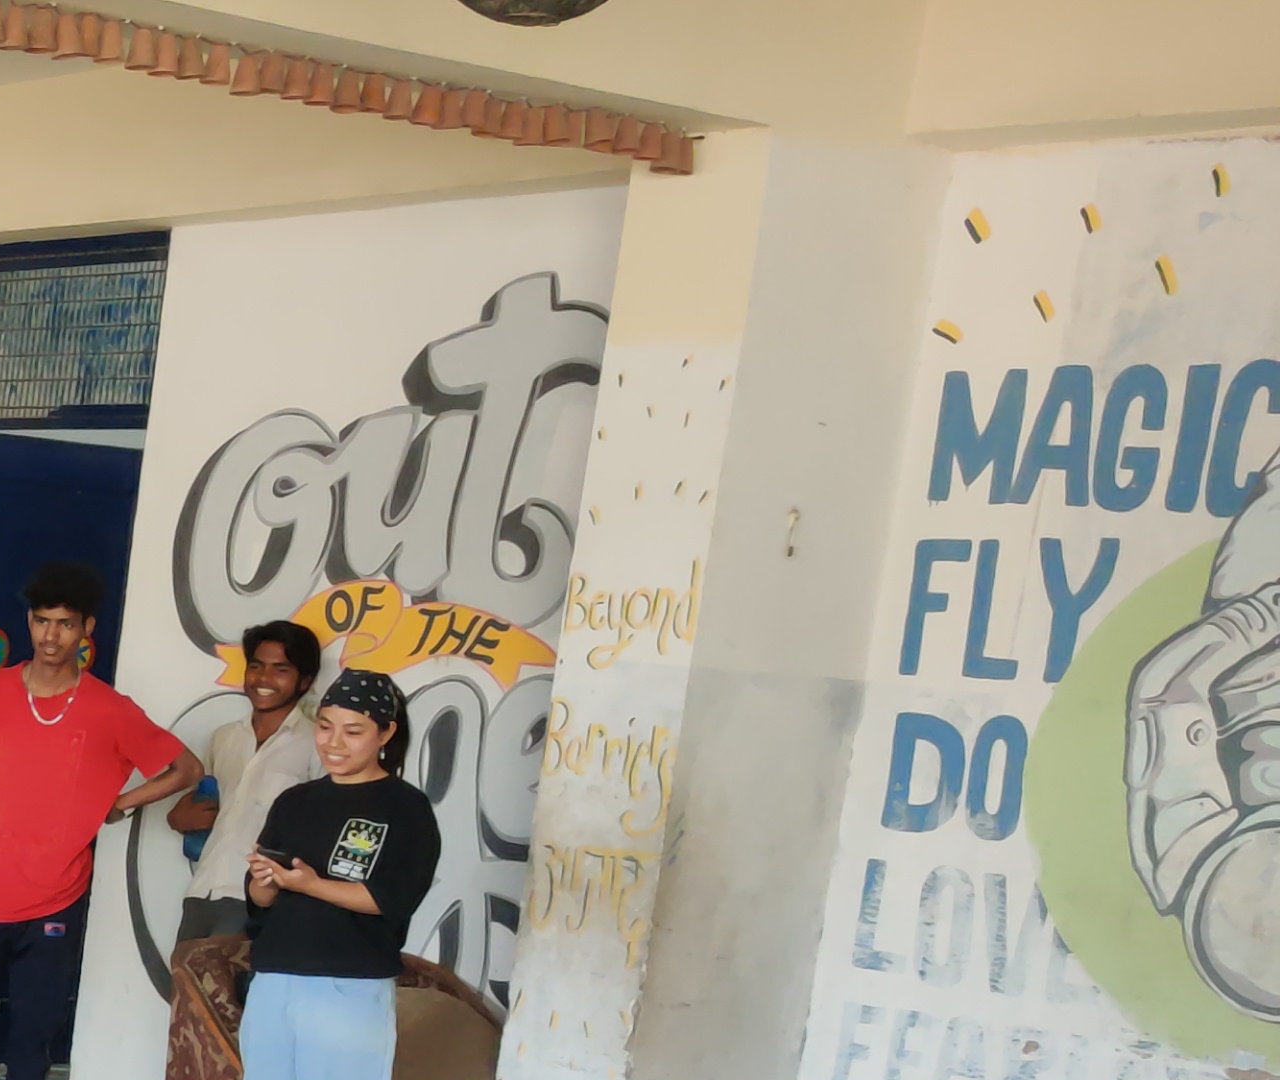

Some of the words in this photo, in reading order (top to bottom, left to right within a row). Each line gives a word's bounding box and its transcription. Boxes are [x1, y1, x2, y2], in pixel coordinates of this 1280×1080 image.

[927, 358, 1280, 518] MAGIC
[325, 584, 387, 634] OF
[407, 604, 511, 665] THE
[898, 537, 1121, 683] FLY
[881, 712, 1027, 841] DO
